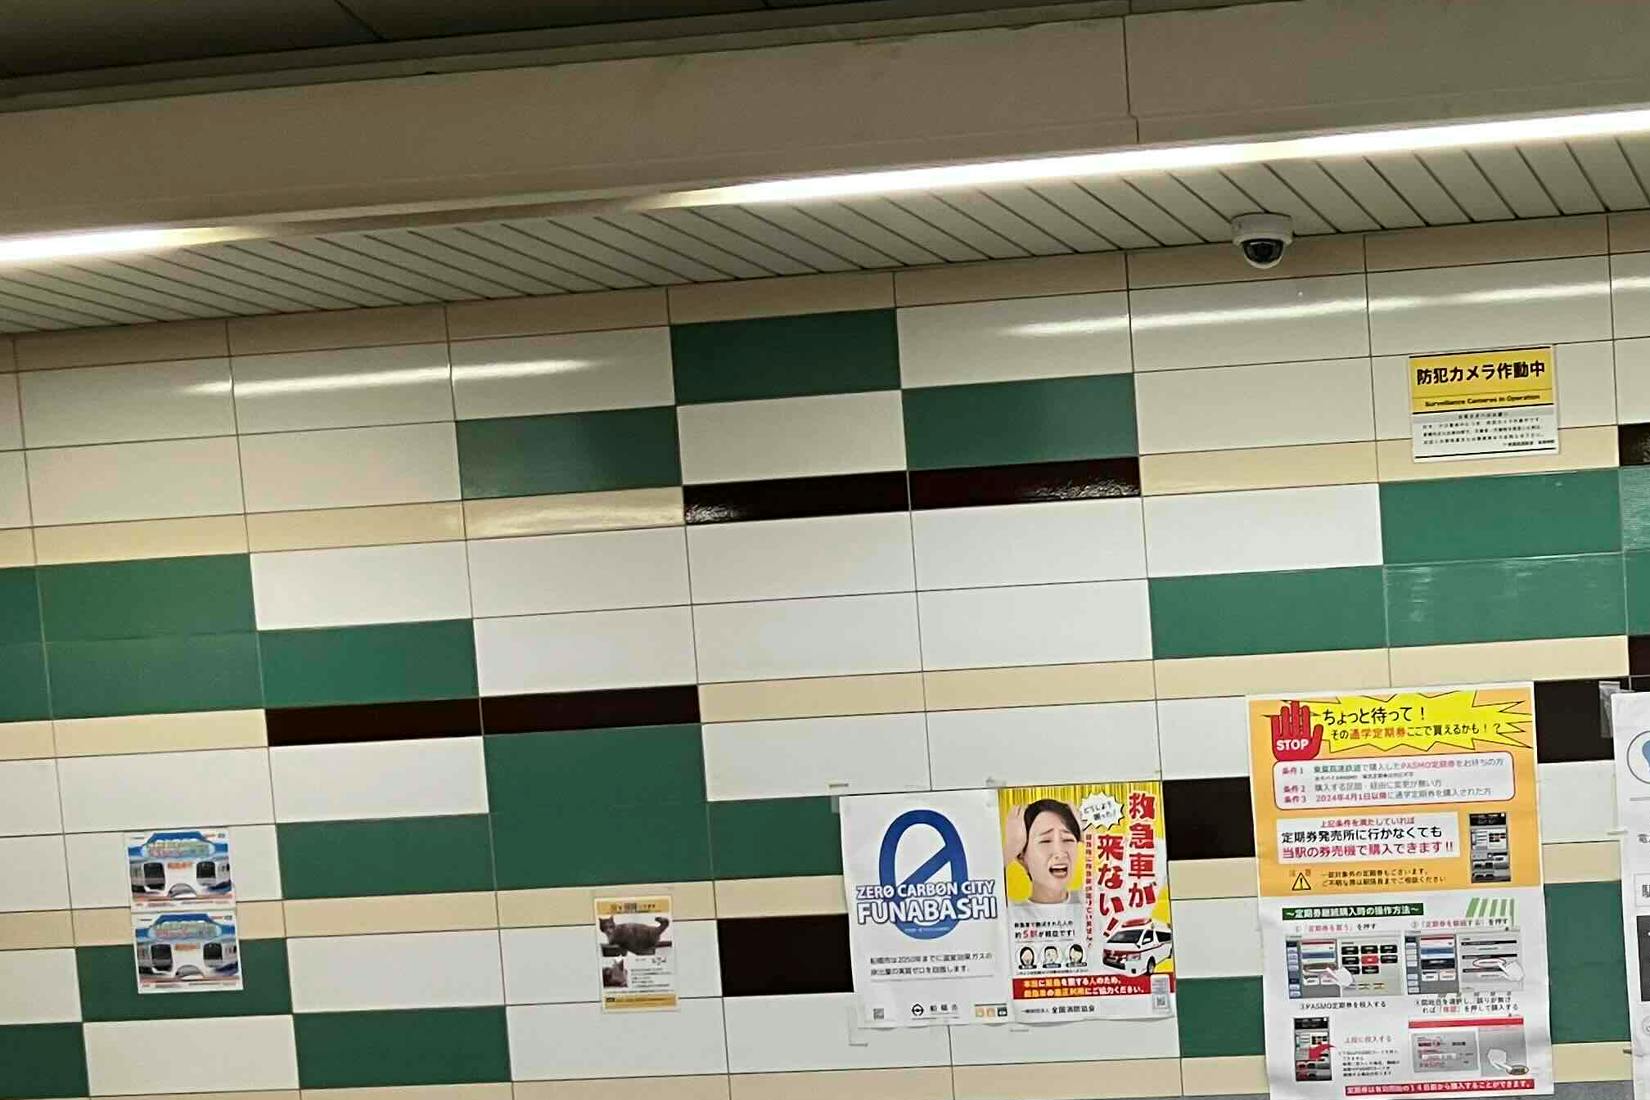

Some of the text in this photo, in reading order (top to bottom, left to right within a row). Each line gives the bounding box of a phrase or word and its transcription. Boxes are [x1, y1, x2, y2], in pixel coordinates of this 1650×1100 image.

[1416, 360, 1545, 385] 防犯カメラ作動中
[1323, 706, 1426, 725] ちょっと待って！
[1276, 738, 1309, 751] STOP
[1281, 826, 1442, 844] 定期券発売所に行かなくても
[1129, 792, 1156, 908] 救急車が
[856, 879, 996, 899] ZERO CARBON CITY
[857, 896, 998, 925] FUNABASHI
